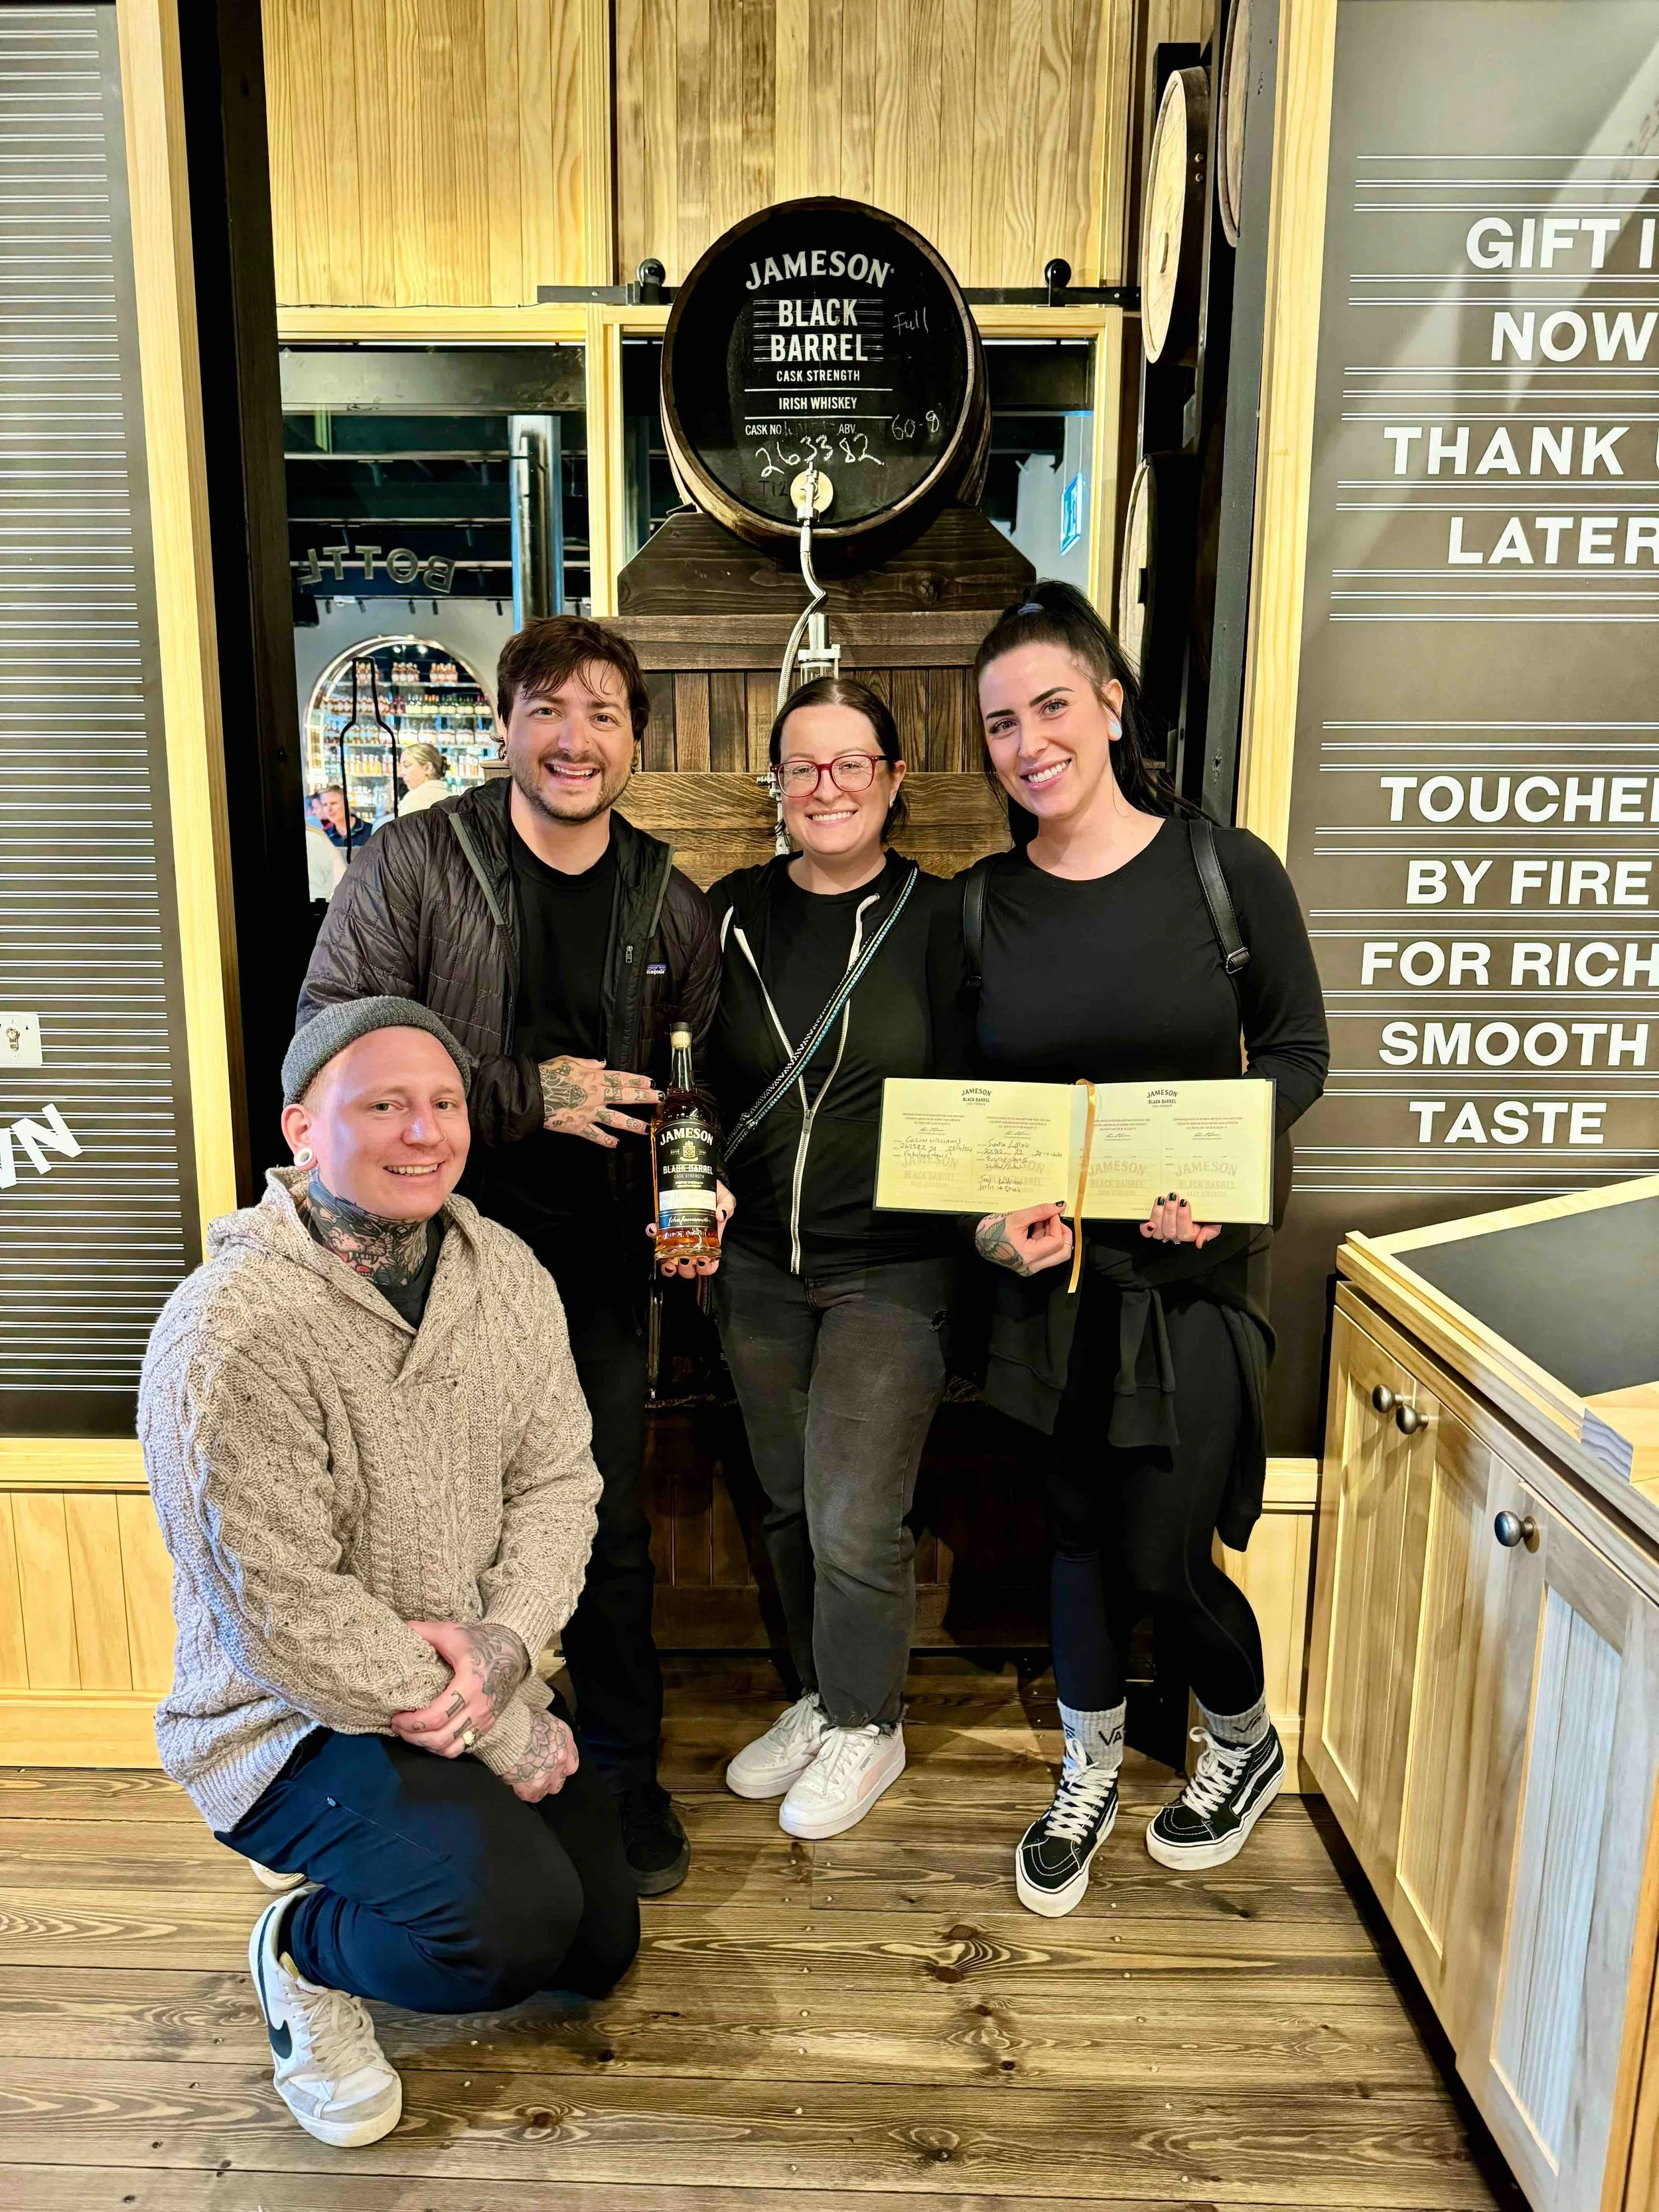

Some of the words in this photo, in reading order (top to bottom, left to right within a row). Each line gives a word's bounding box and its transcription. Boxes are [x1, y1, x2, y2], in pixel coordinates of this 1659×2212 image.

[1466, 217, 1620, 269] GIFT
[745, 250, 891, 290] JAMESON
[778, 299, 858, 327] BLACK
[893, 307, 929, 336] Full
[770, 334, 869, 362] BARREL
[1491, 311, 1659, 362] NOW
[776, 370, 803, 382] CASK
[806, 370, 860, 382] STRENGTH
[778, 397, 808, 410] IRISH
[810, 397, 857, 409] WHISKEY
[745, 424, 768, 436] CASK
[770, 424, 782, 435] NO
[839, 423, 856, 434] ABV
[1384, 427, 1630, 475] THANK
[1447, 516, 1659, 565] LATER
[1380, 775, 1659, 823] TOUCHE
[1406, 860, 1493, 905] BY
[1510, 860, 1652, 906] FIRE
[1361, 941, 1492, 986] FOR
[1510, 942, 1659, 988] RICH
[1378, 1021, 1649, 1067] SMOOTH
[962, 1088, 991, 1096] JAMESON
[1147, 1089, 1178, 1098] JAMESON
[660, 1127, 714, 1147] JAMESON
[1409, 1101, 1607, 1145] TASTE
